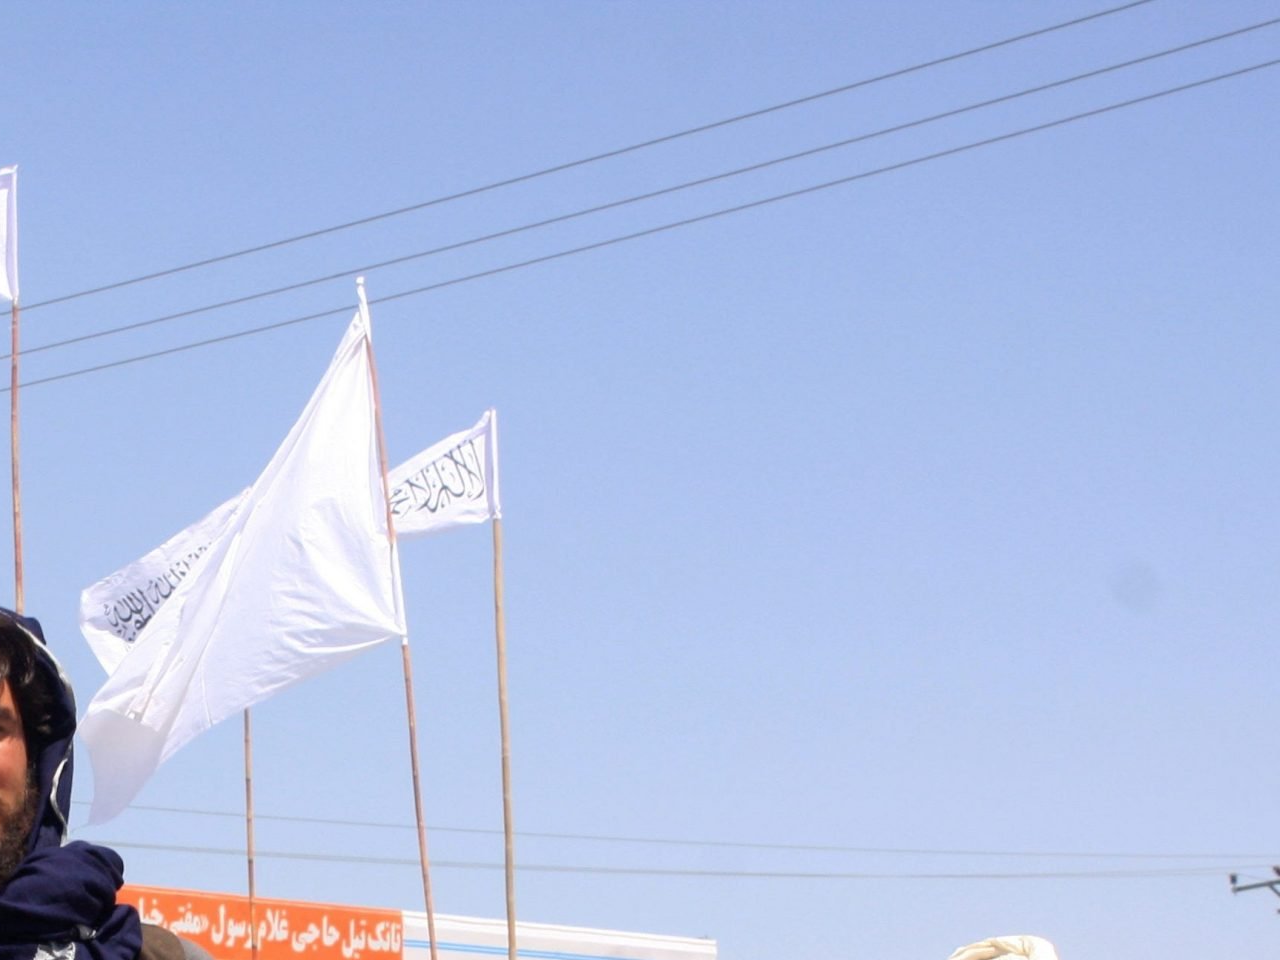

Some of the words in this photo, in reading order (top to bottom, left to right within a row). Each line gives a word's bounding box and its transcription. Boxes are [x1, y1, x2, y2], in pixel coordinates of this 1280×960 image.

[256, 908, 288, 952] غلام
[291, 914, 340, 953] حاجی
[340, 918, 367, 960] تیل
[367, 920, 401, 954] تانک
